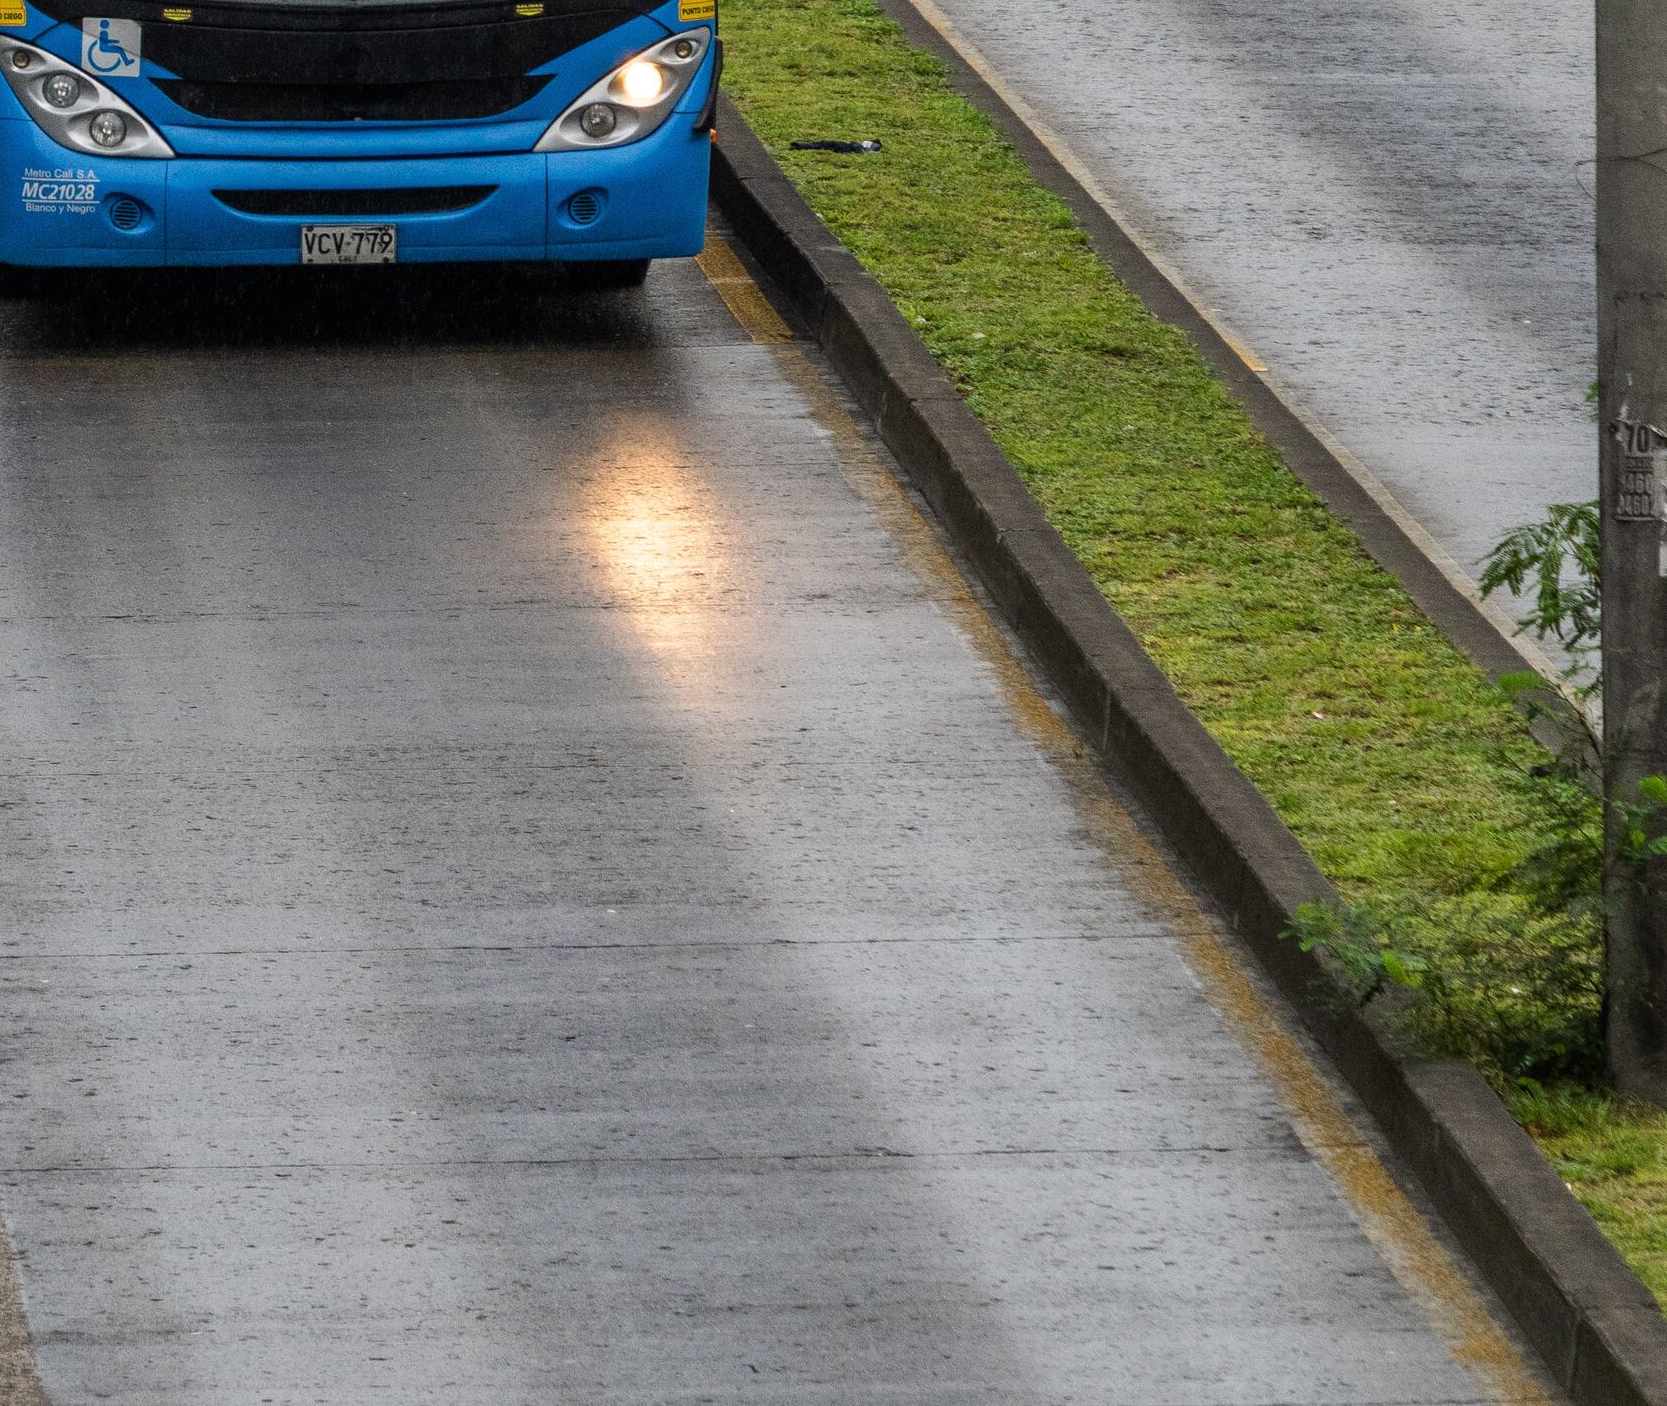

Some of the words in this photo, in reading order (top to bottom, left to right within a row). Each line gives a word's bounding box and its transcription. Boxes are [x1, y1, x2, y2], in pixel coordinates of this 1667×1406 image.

[3, 12, 23, 20] CIEGO
[682, 6, 701, 16] PUNTO
[24, 167, 52, 177] Metro
[54, 168, 74, 178] Cali
[21, 182, 95, 200] MC21028
[26, 203, 57, 212] Blanco
[58, 205, 65, 214] y
[66, 204, 96, 214] Negro
